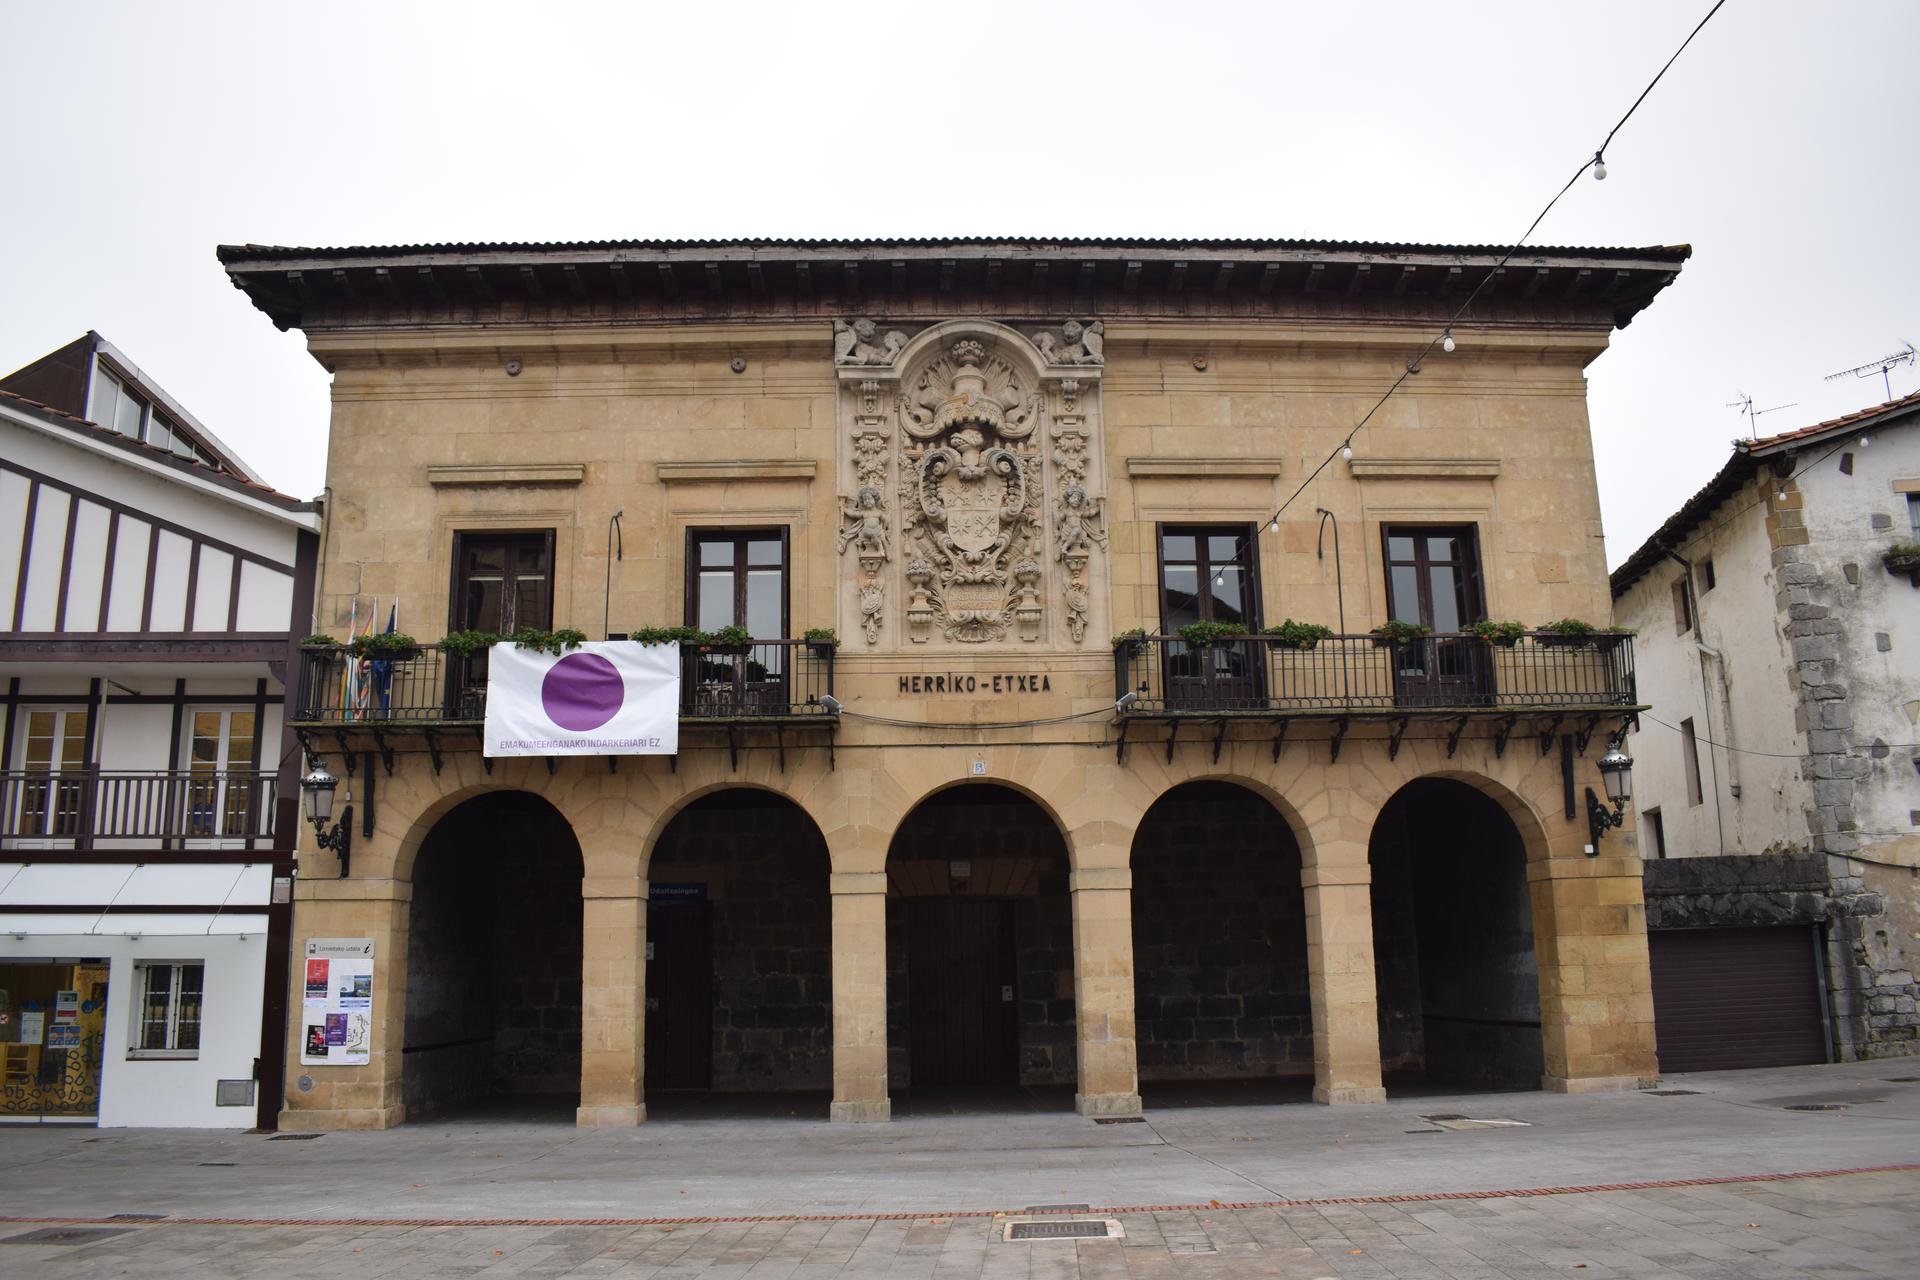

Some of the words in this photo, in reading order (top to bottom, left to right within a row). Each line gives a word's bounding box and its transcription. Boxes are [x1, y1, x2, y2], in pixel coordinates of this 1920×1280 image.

[500, 740, 586, 749] EMAKUMEENGANAKO
[588, 739, 647, 748] INDARKERIARI
[649, 738, 660, 747] EZ
